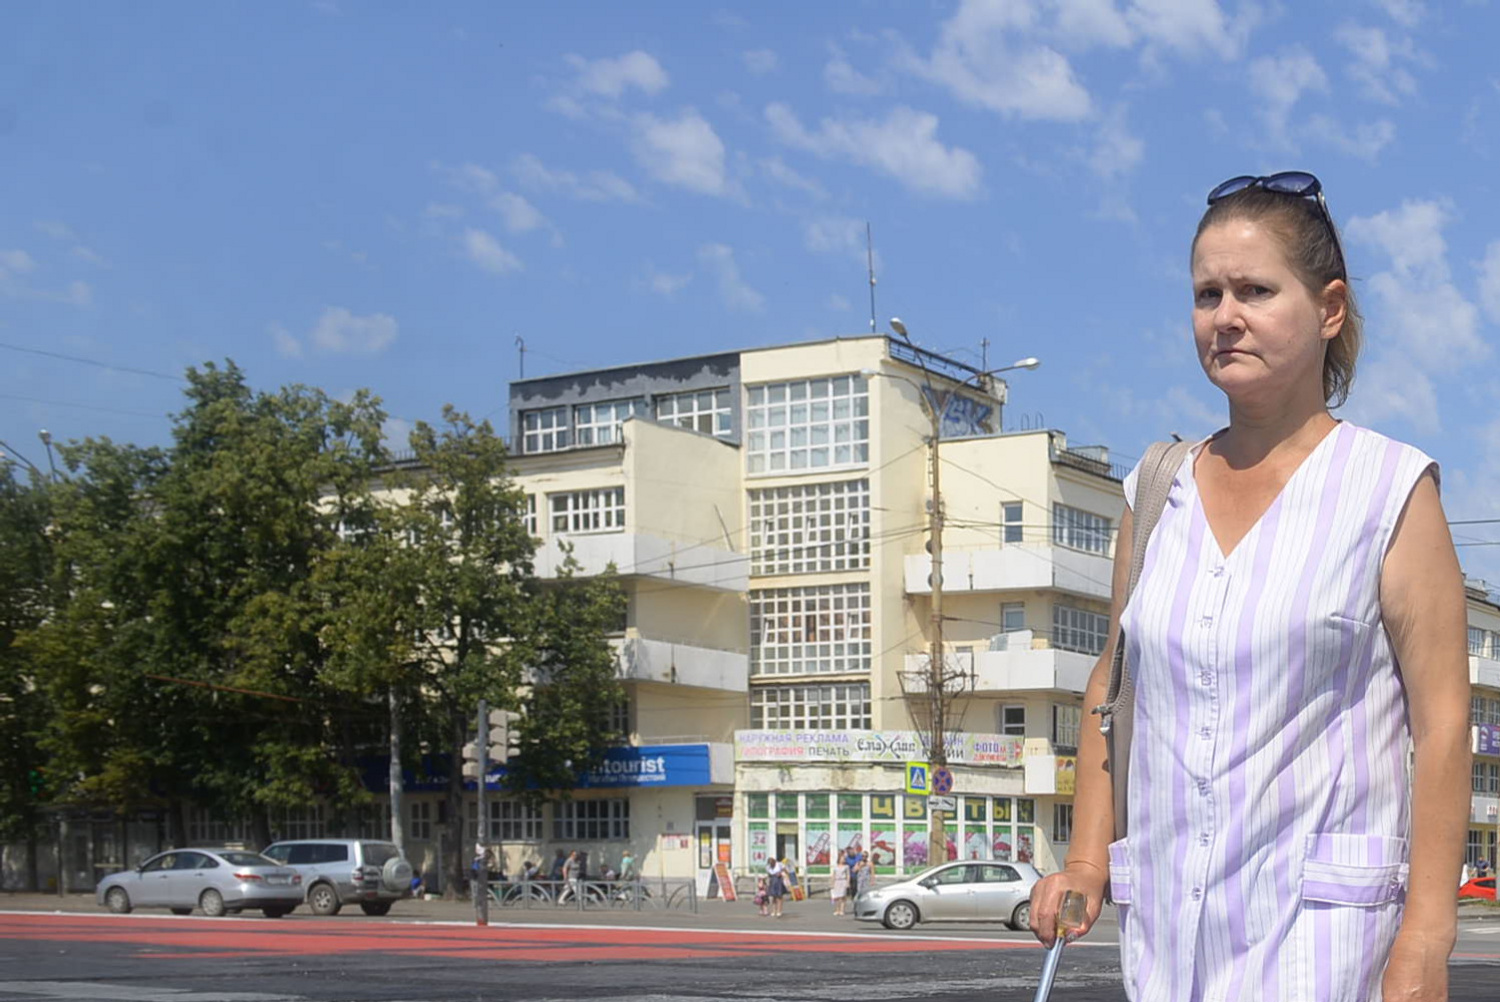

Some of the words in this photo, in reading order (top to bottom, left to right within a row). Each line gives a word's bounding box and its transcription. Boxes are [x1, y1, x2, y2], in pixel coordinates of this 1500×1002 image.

[739, 733, 792, 743] НАРУЖНАЯ
[796, 733, 849, 744] РЕКЛАМА
[808, 746, 850, 757] ПЕЧАТЬ
[973, 742, 999, 753] ФОТО
[872, 797, 1011, 820] ЦВТЫ
